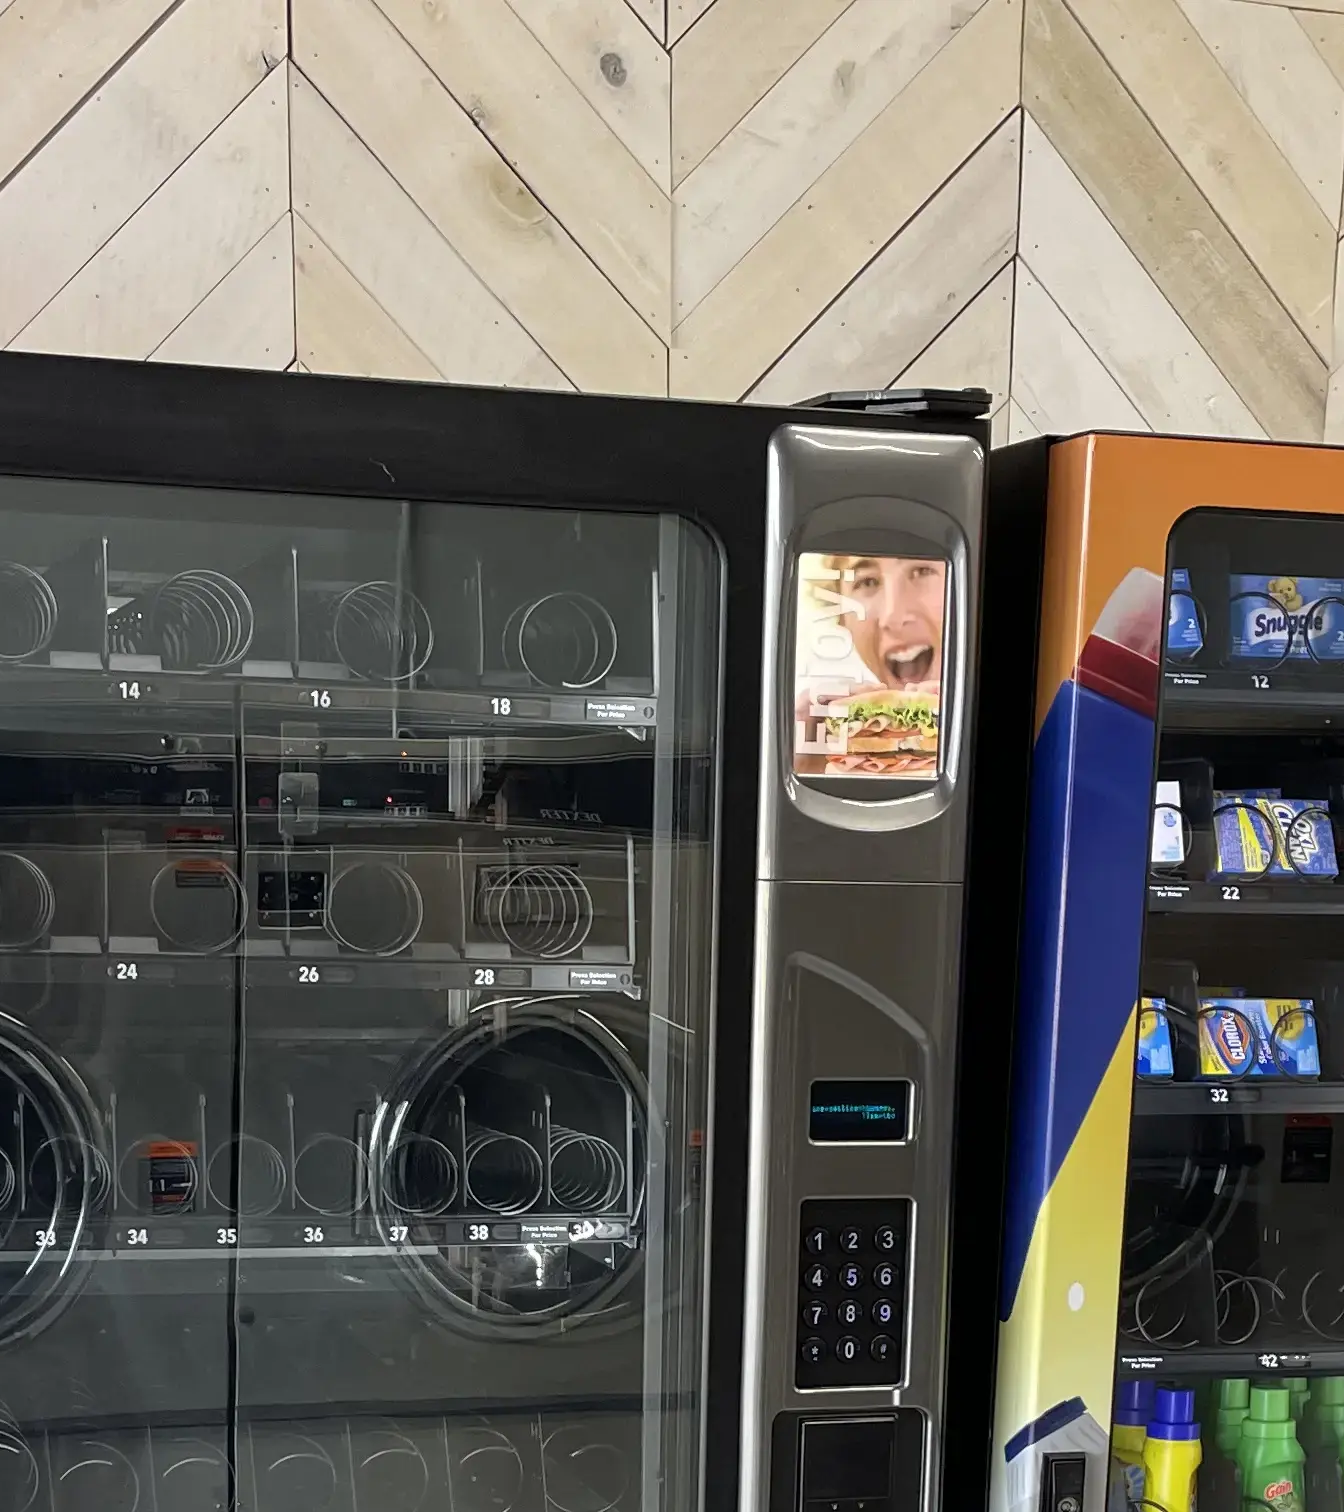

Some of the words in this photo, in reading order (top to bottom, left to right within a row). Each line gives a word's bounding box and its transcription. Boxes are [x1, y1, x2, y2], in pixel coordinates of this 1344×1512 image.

[795, 568, 866, 755] Enjoy!
[119, 681, 141, 699] 14
[1251, 675, 1270, 689] 12
[310, 690, 331, 708] 16
[491, 697, 511, 716] 18
[1221, 886, 1241, 900] 22
[116, 963, 138, 980] 24
[298, 966, 319, 983] 26
[474, 968, 495, 986] 28
[1210, 1088, 1229, 1103] 32
[35, 1229, 57, 1247] 33
[127, 1228, 149, 1245] 34
[216, 1228, 237, 1244] 35
[303, 1226, 324, 1243] 36
[389, 1225, 409, 1242] 37
[469, 1224, 489, 1241] 38
[814, 1232, 823, 1250] 1
[848, 1232, 858, 1249] 2
[882, 1231, 894, 1249] 3
[812, 1269, 823, 1287] 4
[846, 1268, 857, 1287] 5
[880, 1267, 892, 1286] 6
[812, 1306, 822, 1325] 7
[846, 1305, 856, 1323] 8
[879, 1304, 891, 1322] 9
[844, 1341, 855, 1359] 0
[1265, 1481, 1293, 1499] Gain
